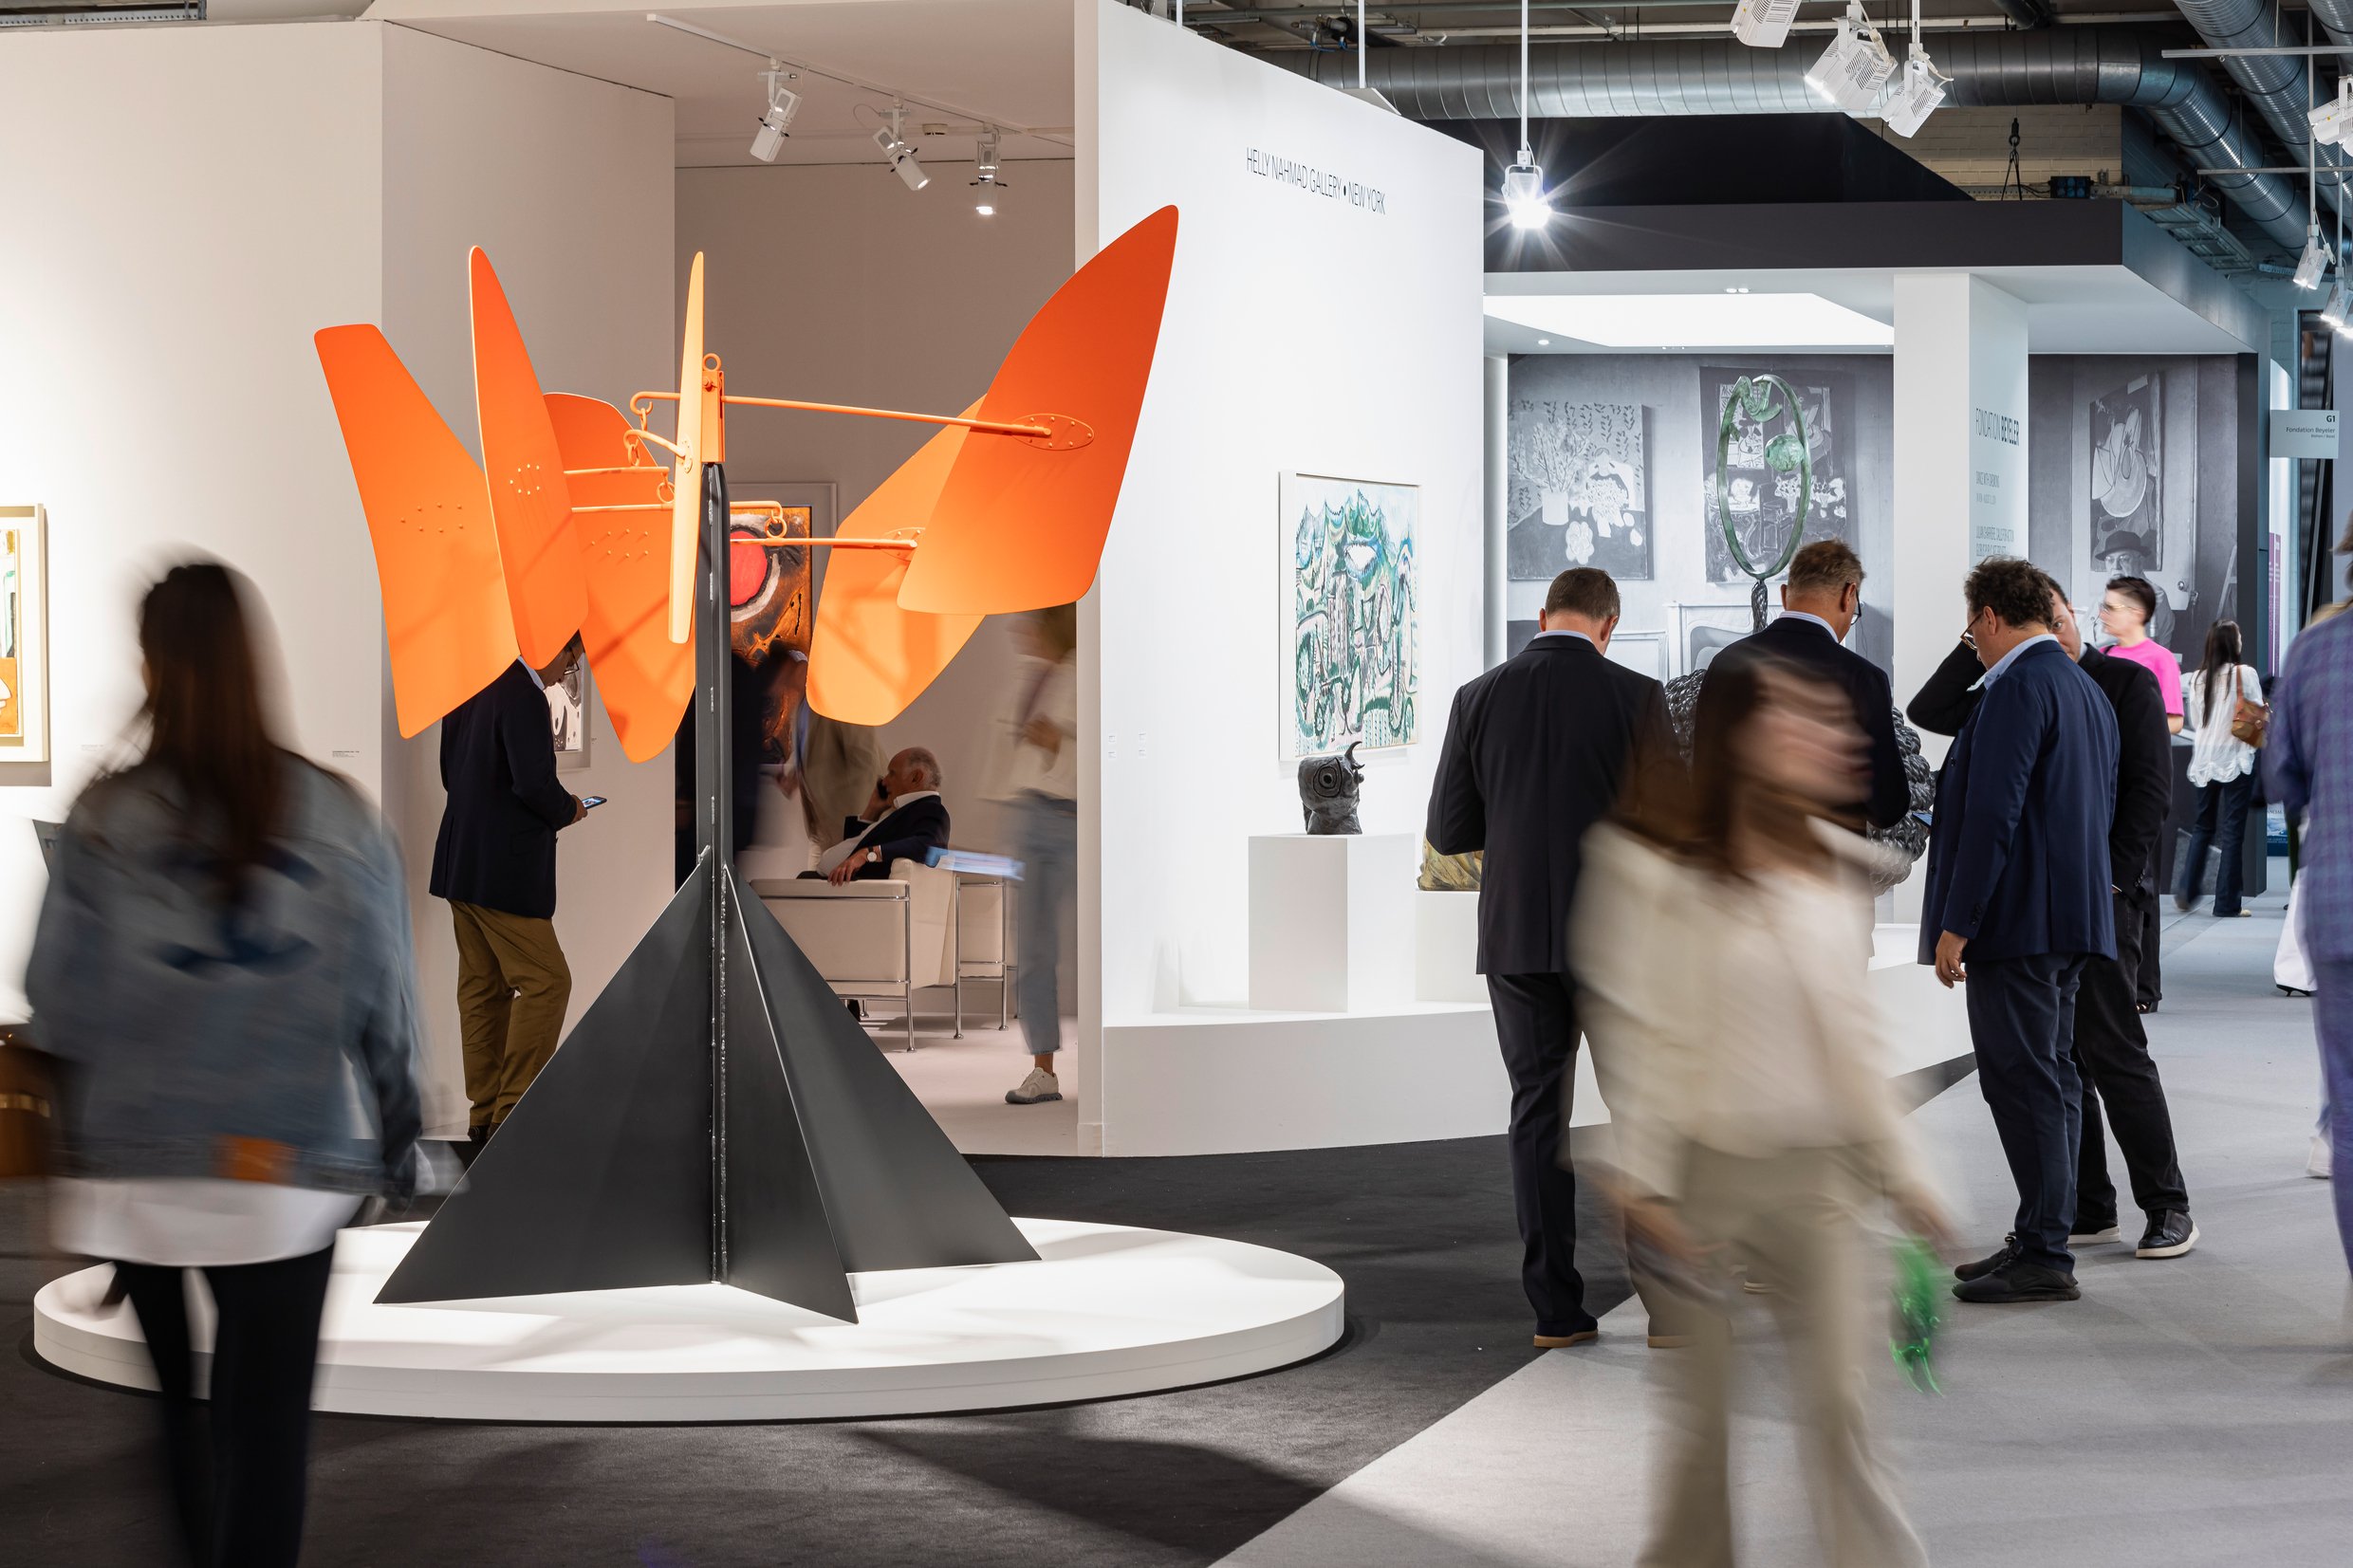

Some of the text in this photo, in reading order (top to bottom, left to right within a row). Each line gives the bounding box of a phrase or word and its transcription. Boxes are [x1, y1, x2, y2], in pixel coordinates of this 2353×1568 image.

[1247, 147, 1385, 215] HELLY NAHMAD GALLERY NEW YORK
[2001, 415, 2020, 446] BEYELER
